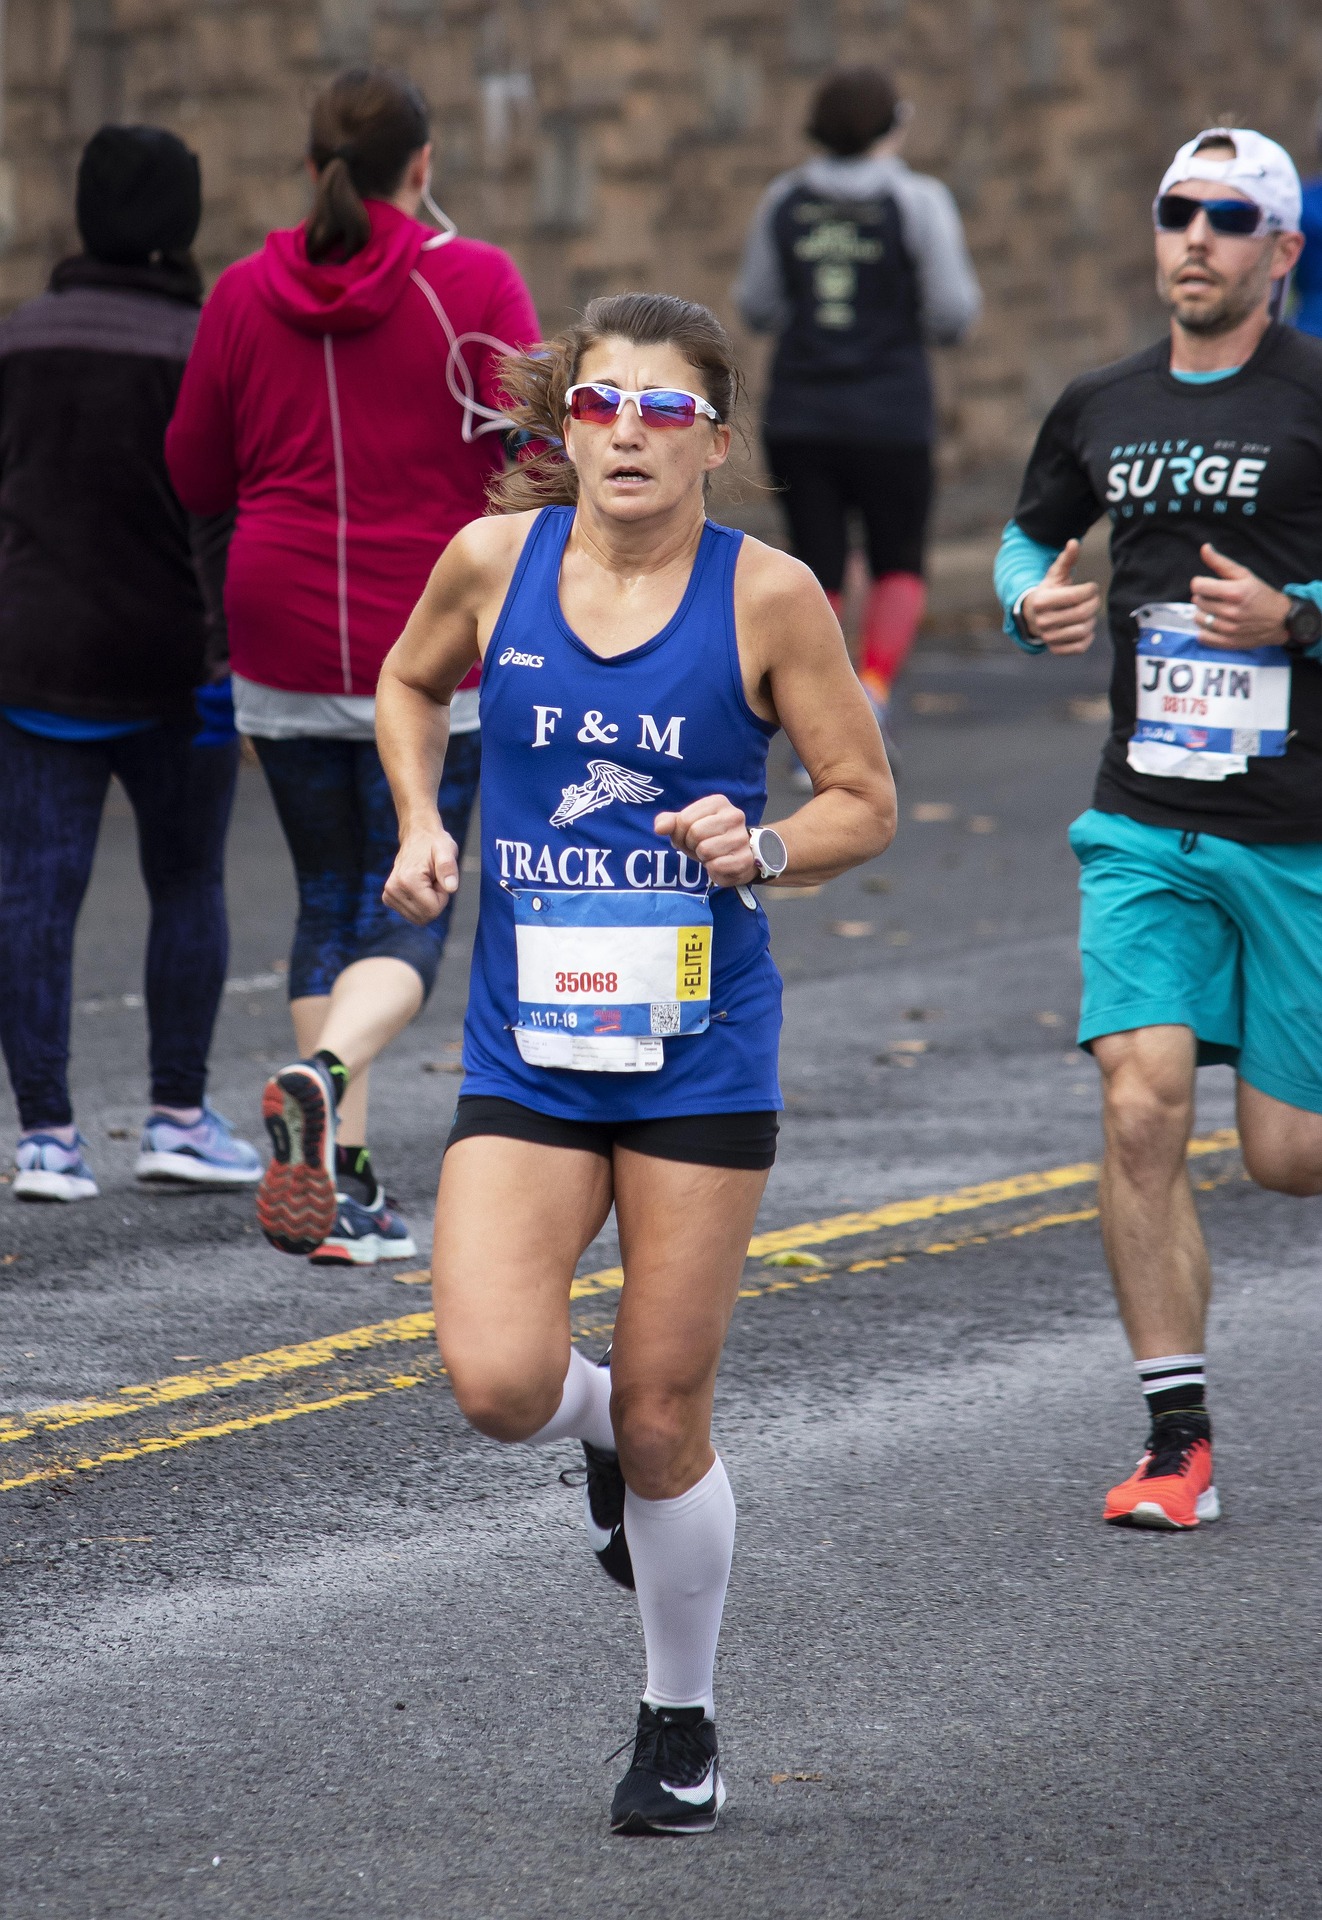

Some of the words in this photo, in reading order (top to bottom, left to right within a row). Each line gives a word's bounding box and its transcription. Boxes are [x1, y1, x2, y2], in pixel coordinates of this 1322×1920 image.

[1110, 438, 1190, 461] PHILLY
[1105, 454, 1267, 502] SURGE
[1142, 659, 1251, 699] JOHN
[531, 705, 563, 748] F
[577, 710, 619, 744] &
[636, 714, 686, 760] M
[496, 839, 613, 887] TRACK
[625, 850, 718, 888] CLU
[555, 971, 618, 994] 35068
[683, 941, 703, 988] ELITE
[530, 1010, 578, 1029] 11-17-18
